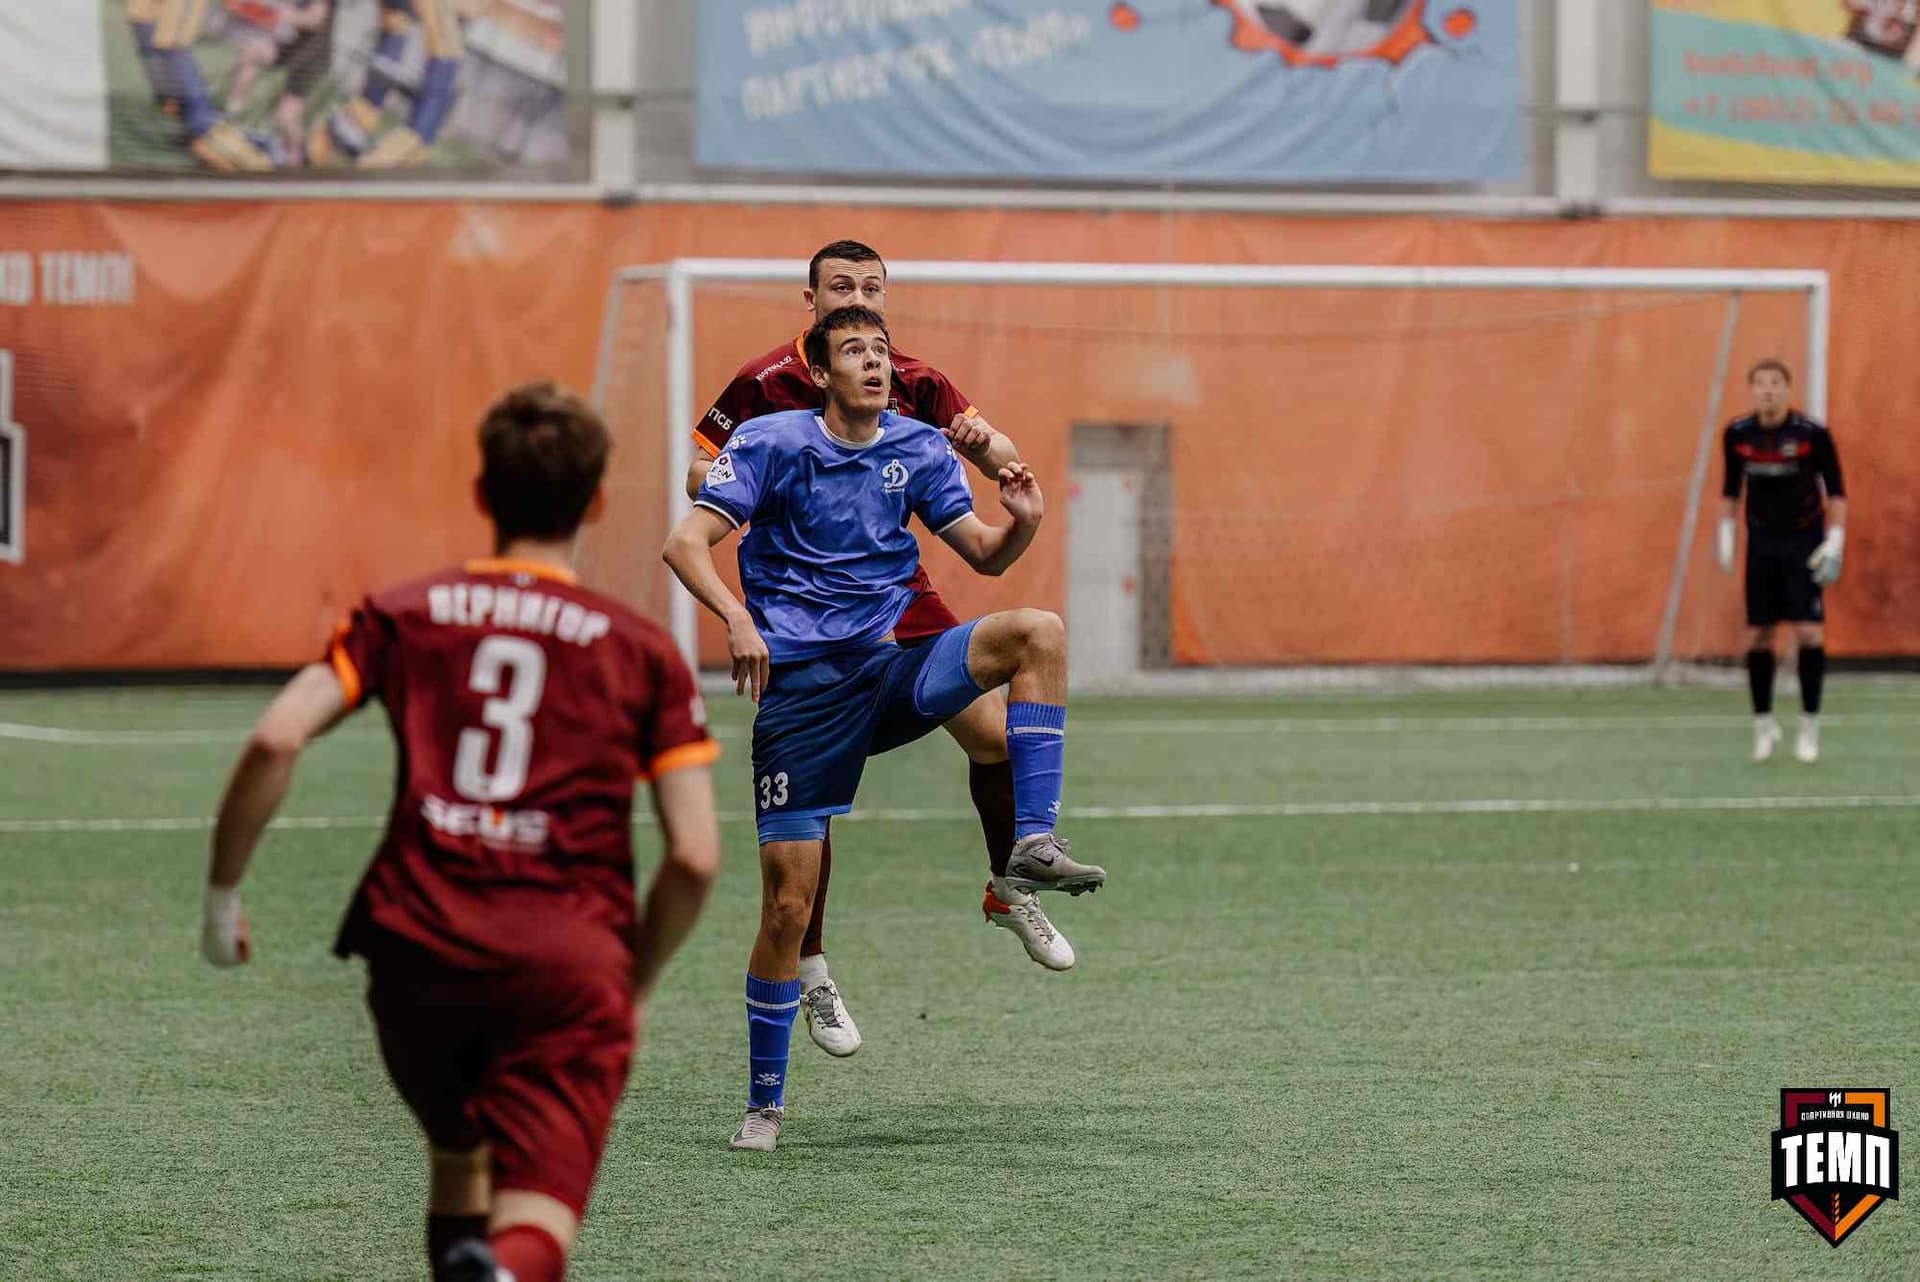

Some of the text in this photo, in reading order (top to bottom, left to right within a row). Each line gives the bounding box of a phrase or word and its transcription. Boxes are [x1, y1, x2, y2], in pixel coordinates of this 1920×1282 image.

[708, 407, 733, 430] ПСБ
[452, 634, 548, 802] 3
[760, 772, 788, 809] 33
